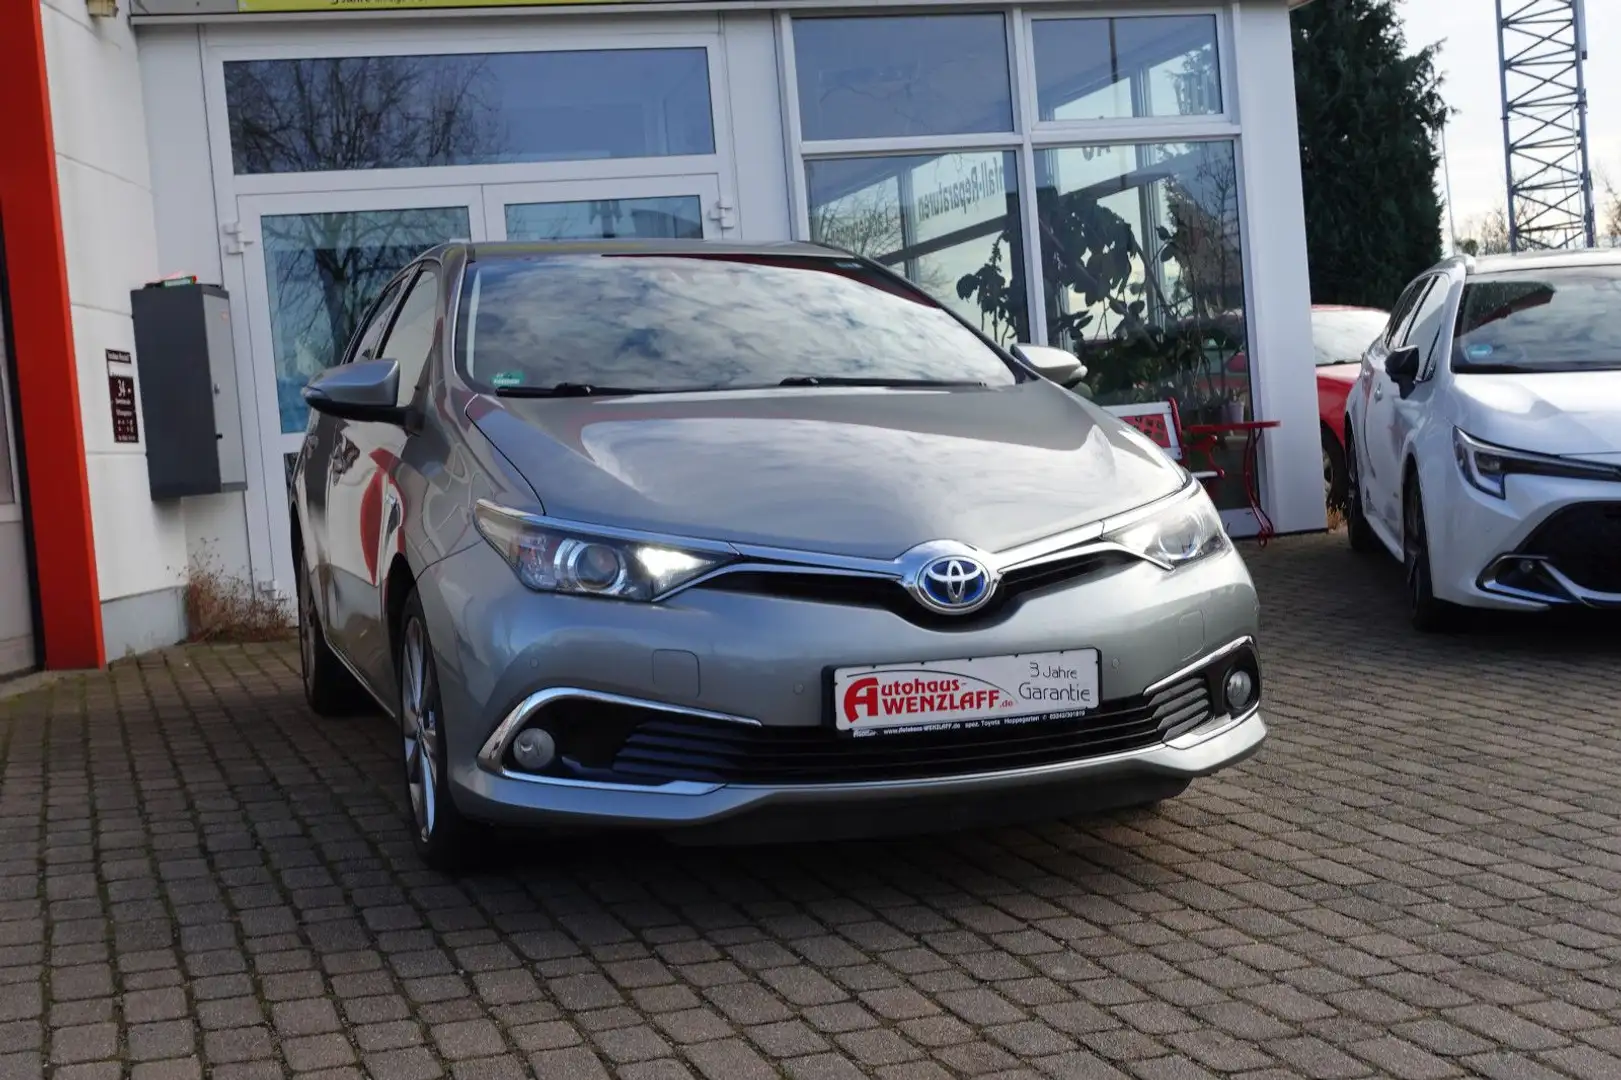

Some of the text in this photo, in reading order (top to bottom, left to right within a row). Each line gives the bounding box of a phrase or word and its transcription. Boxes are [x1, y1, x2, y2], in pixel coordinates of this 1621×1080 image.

[1030, 662, 1077, 680] 3 Jahre
[1018, 681, 1091, 702] Garantie
[981, 719, 1000, 727] Toyota
